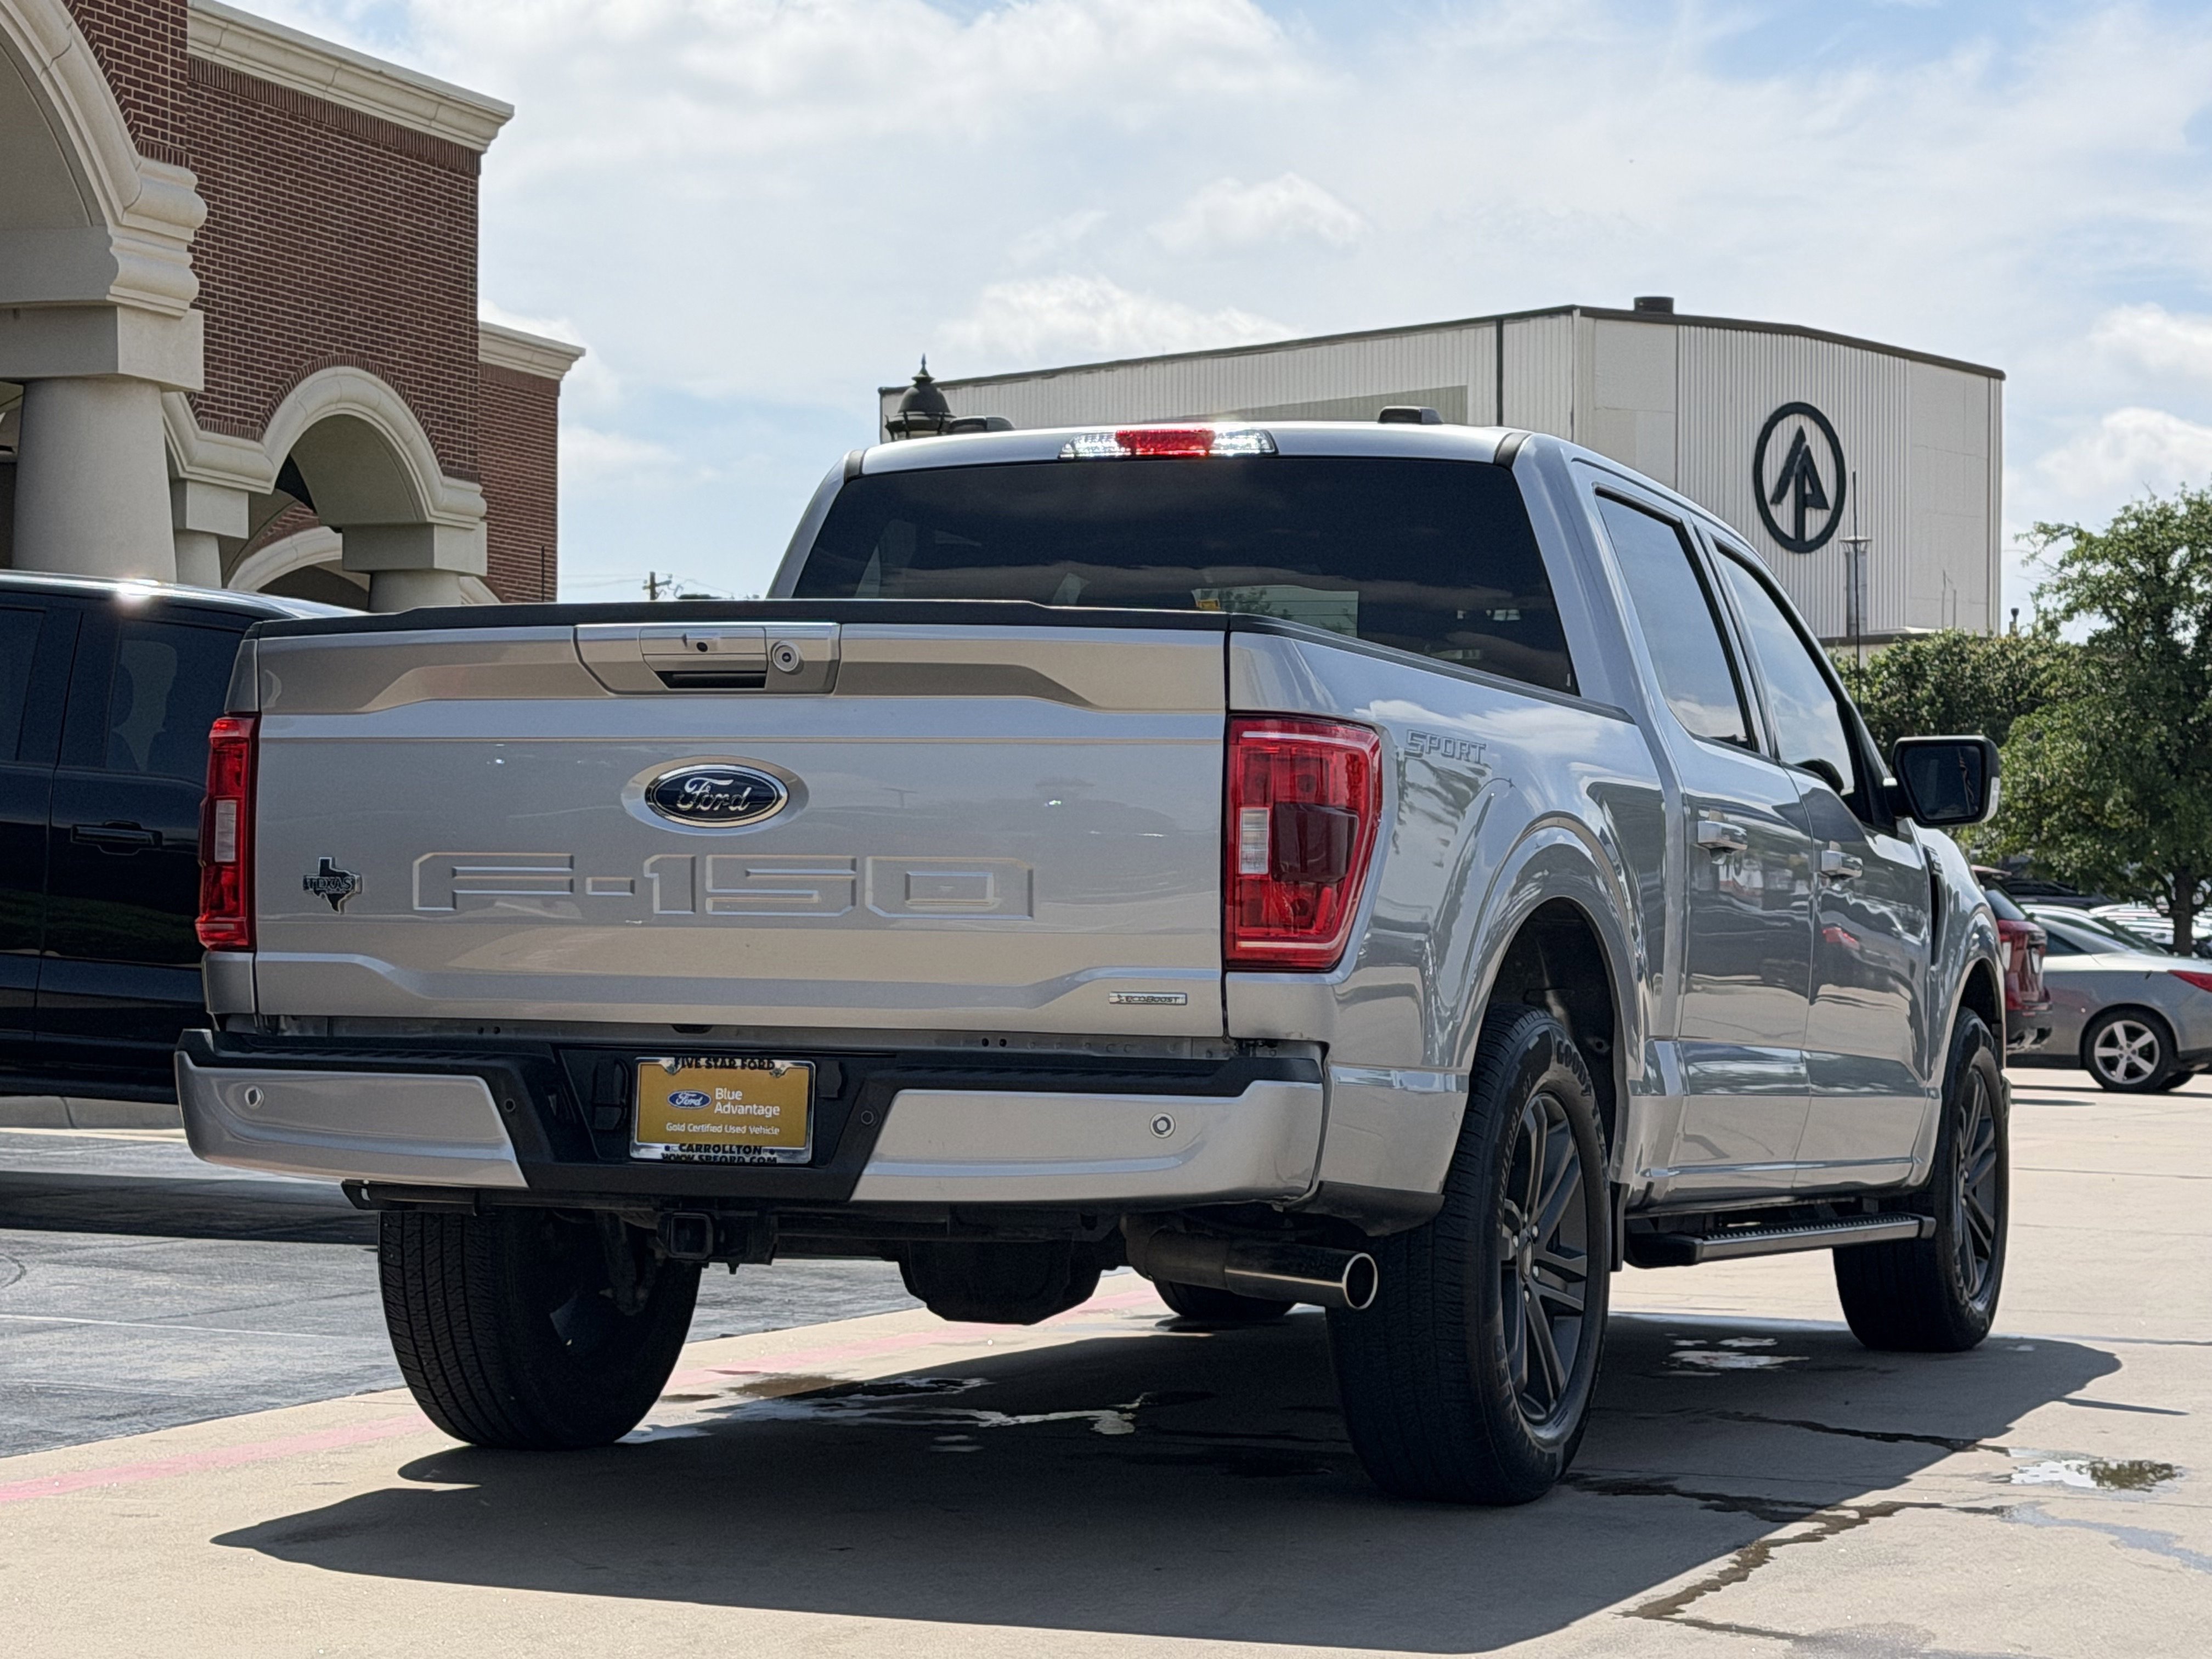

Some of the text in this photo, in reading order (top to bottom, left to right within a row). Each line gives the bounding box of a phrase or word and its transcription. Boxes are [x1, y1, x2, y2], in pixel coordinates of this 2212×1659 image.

[1407, 729, 1487, 765] SPORT
[676, 776, 752, 811] Ford
[412, 851, 1035, 921] F-150
[704, 1057, 737, 1070] STAR
[740, 1058, 775, 1070] FORD
[675, 1091, 704, 1107] Ford
[715, 1087, 743, 1101] Blue
[714, 1102, 781, 1118] Advantage
[666, 1122, 780, 1136] Gold Certified Used Vehicle
[678, 1143, 763, 1155] CARROLLTON
